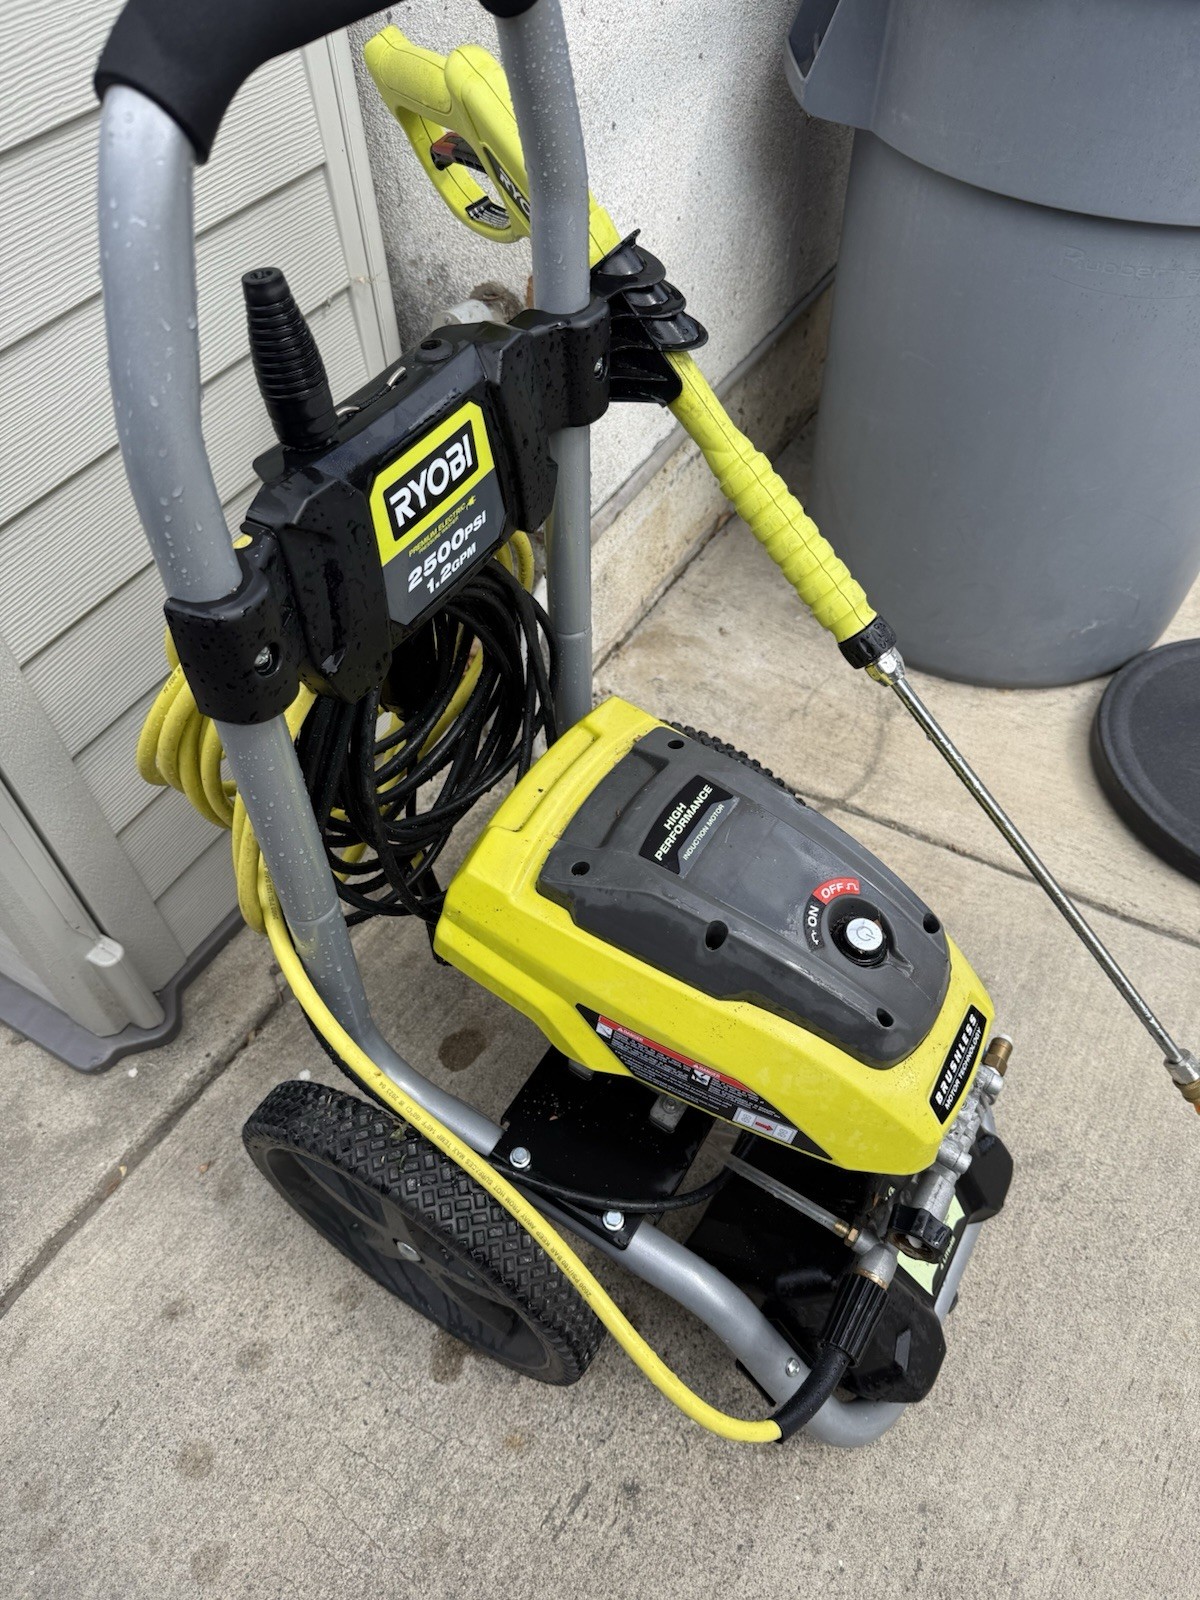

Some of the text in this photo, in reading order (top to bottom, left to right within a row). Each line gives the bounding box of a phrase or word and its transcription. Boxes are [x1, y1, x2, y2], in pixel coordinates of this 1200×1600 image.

[389, 433, 473, 528] RYOBI
[408, 502, 466, 557] PREMIUM ELECTRIC
[407, 510, 487, 593] 2500PSI
[426, 541, 477, 594] 1.2GPM
[654, 784, 713, 861] PERFORMANCE
[663, 802, 687, 830] HIGH
[683, 803, 725, 861] INDUCTION MOTOR
[821, 882, 844, 899] OFF
[807, 905, 820, 927] ON
[935, 1013, 977, 1106] BRUSHLESS
[945, 1026, 982, 1110] MOTOR TECHNOLOGY
[436, 1134, 451, 1149] TEMP
[452, 1147, 466, 1160] MAX
[493, 1185, 506, 1198] HOT
[505, 1197, 521, 1214] FROM
[520, 1213, 537, 1230] AWAY
[536, 1231, 551, 1247] KEEP
[550, 1246, 563, 1261] BAR
[579, 1282, 592, 1298] 2600
